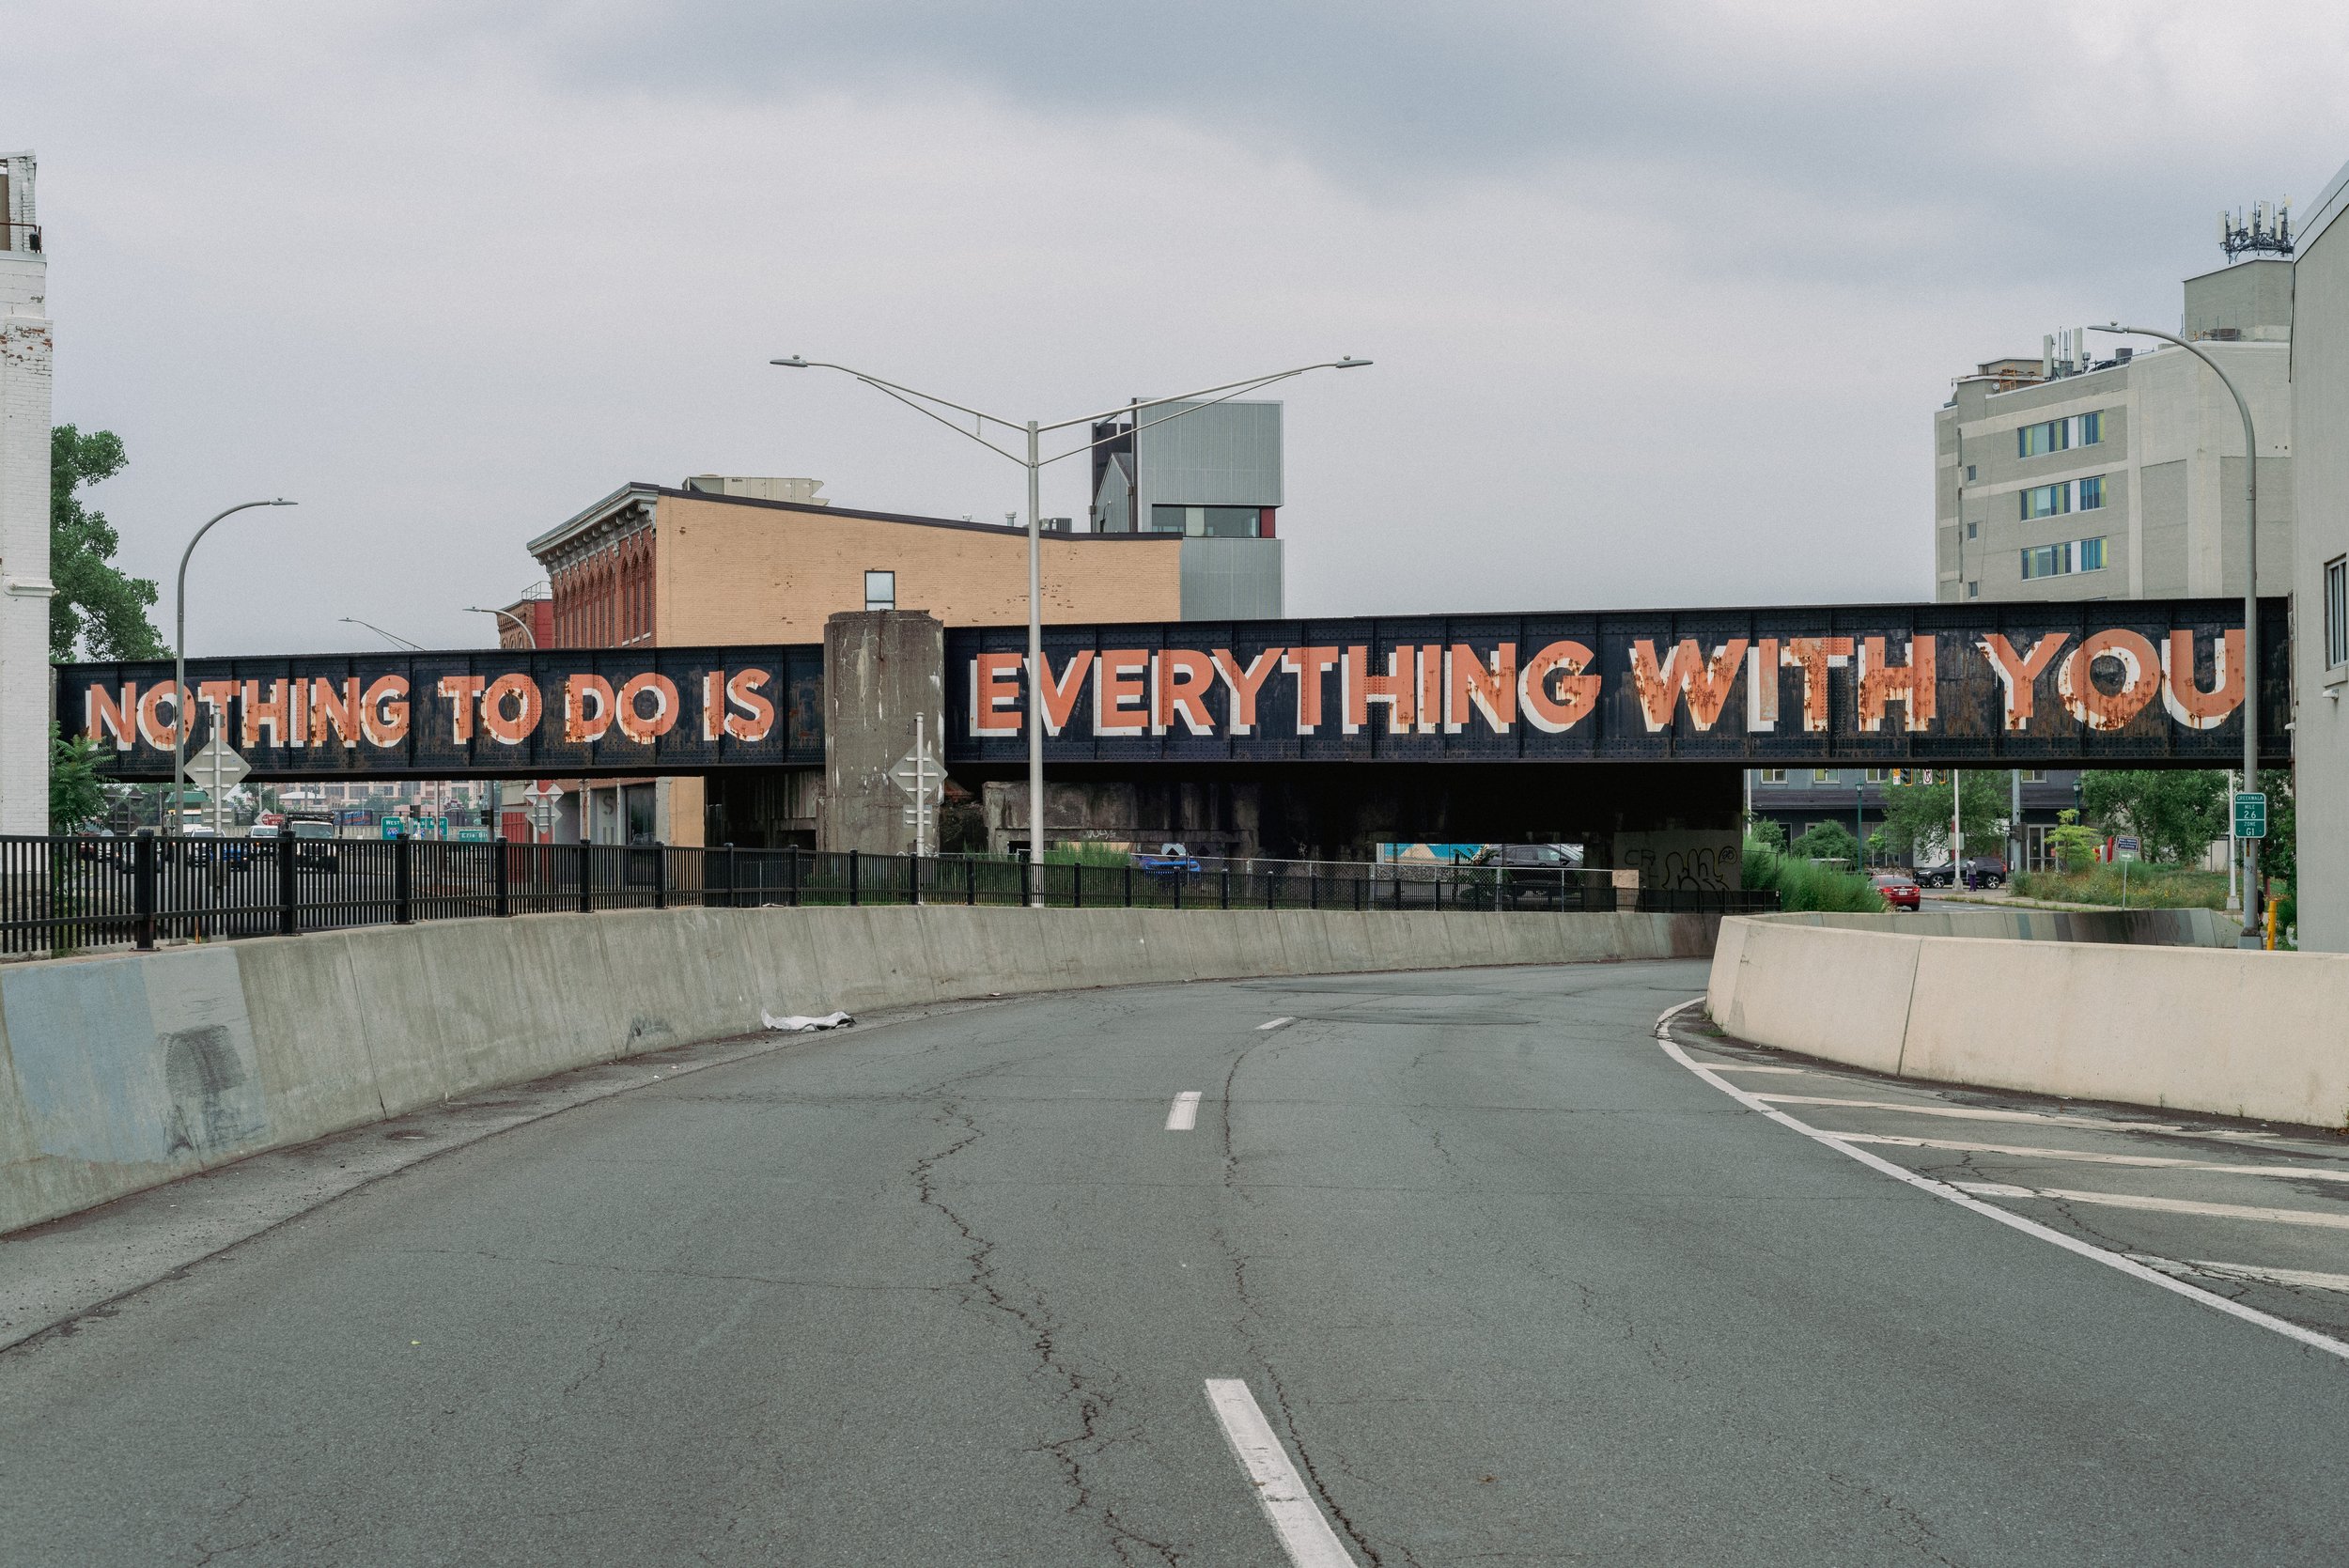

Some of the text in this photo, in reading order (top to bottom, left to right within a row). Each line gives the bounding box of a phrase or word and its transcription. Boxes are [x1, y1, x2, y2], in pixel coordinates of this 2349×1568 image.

[86, 668, 775, 751] NOTHING TO DO IS
[970, 629, 2247, 737] EVERYTHING WITH YOU
